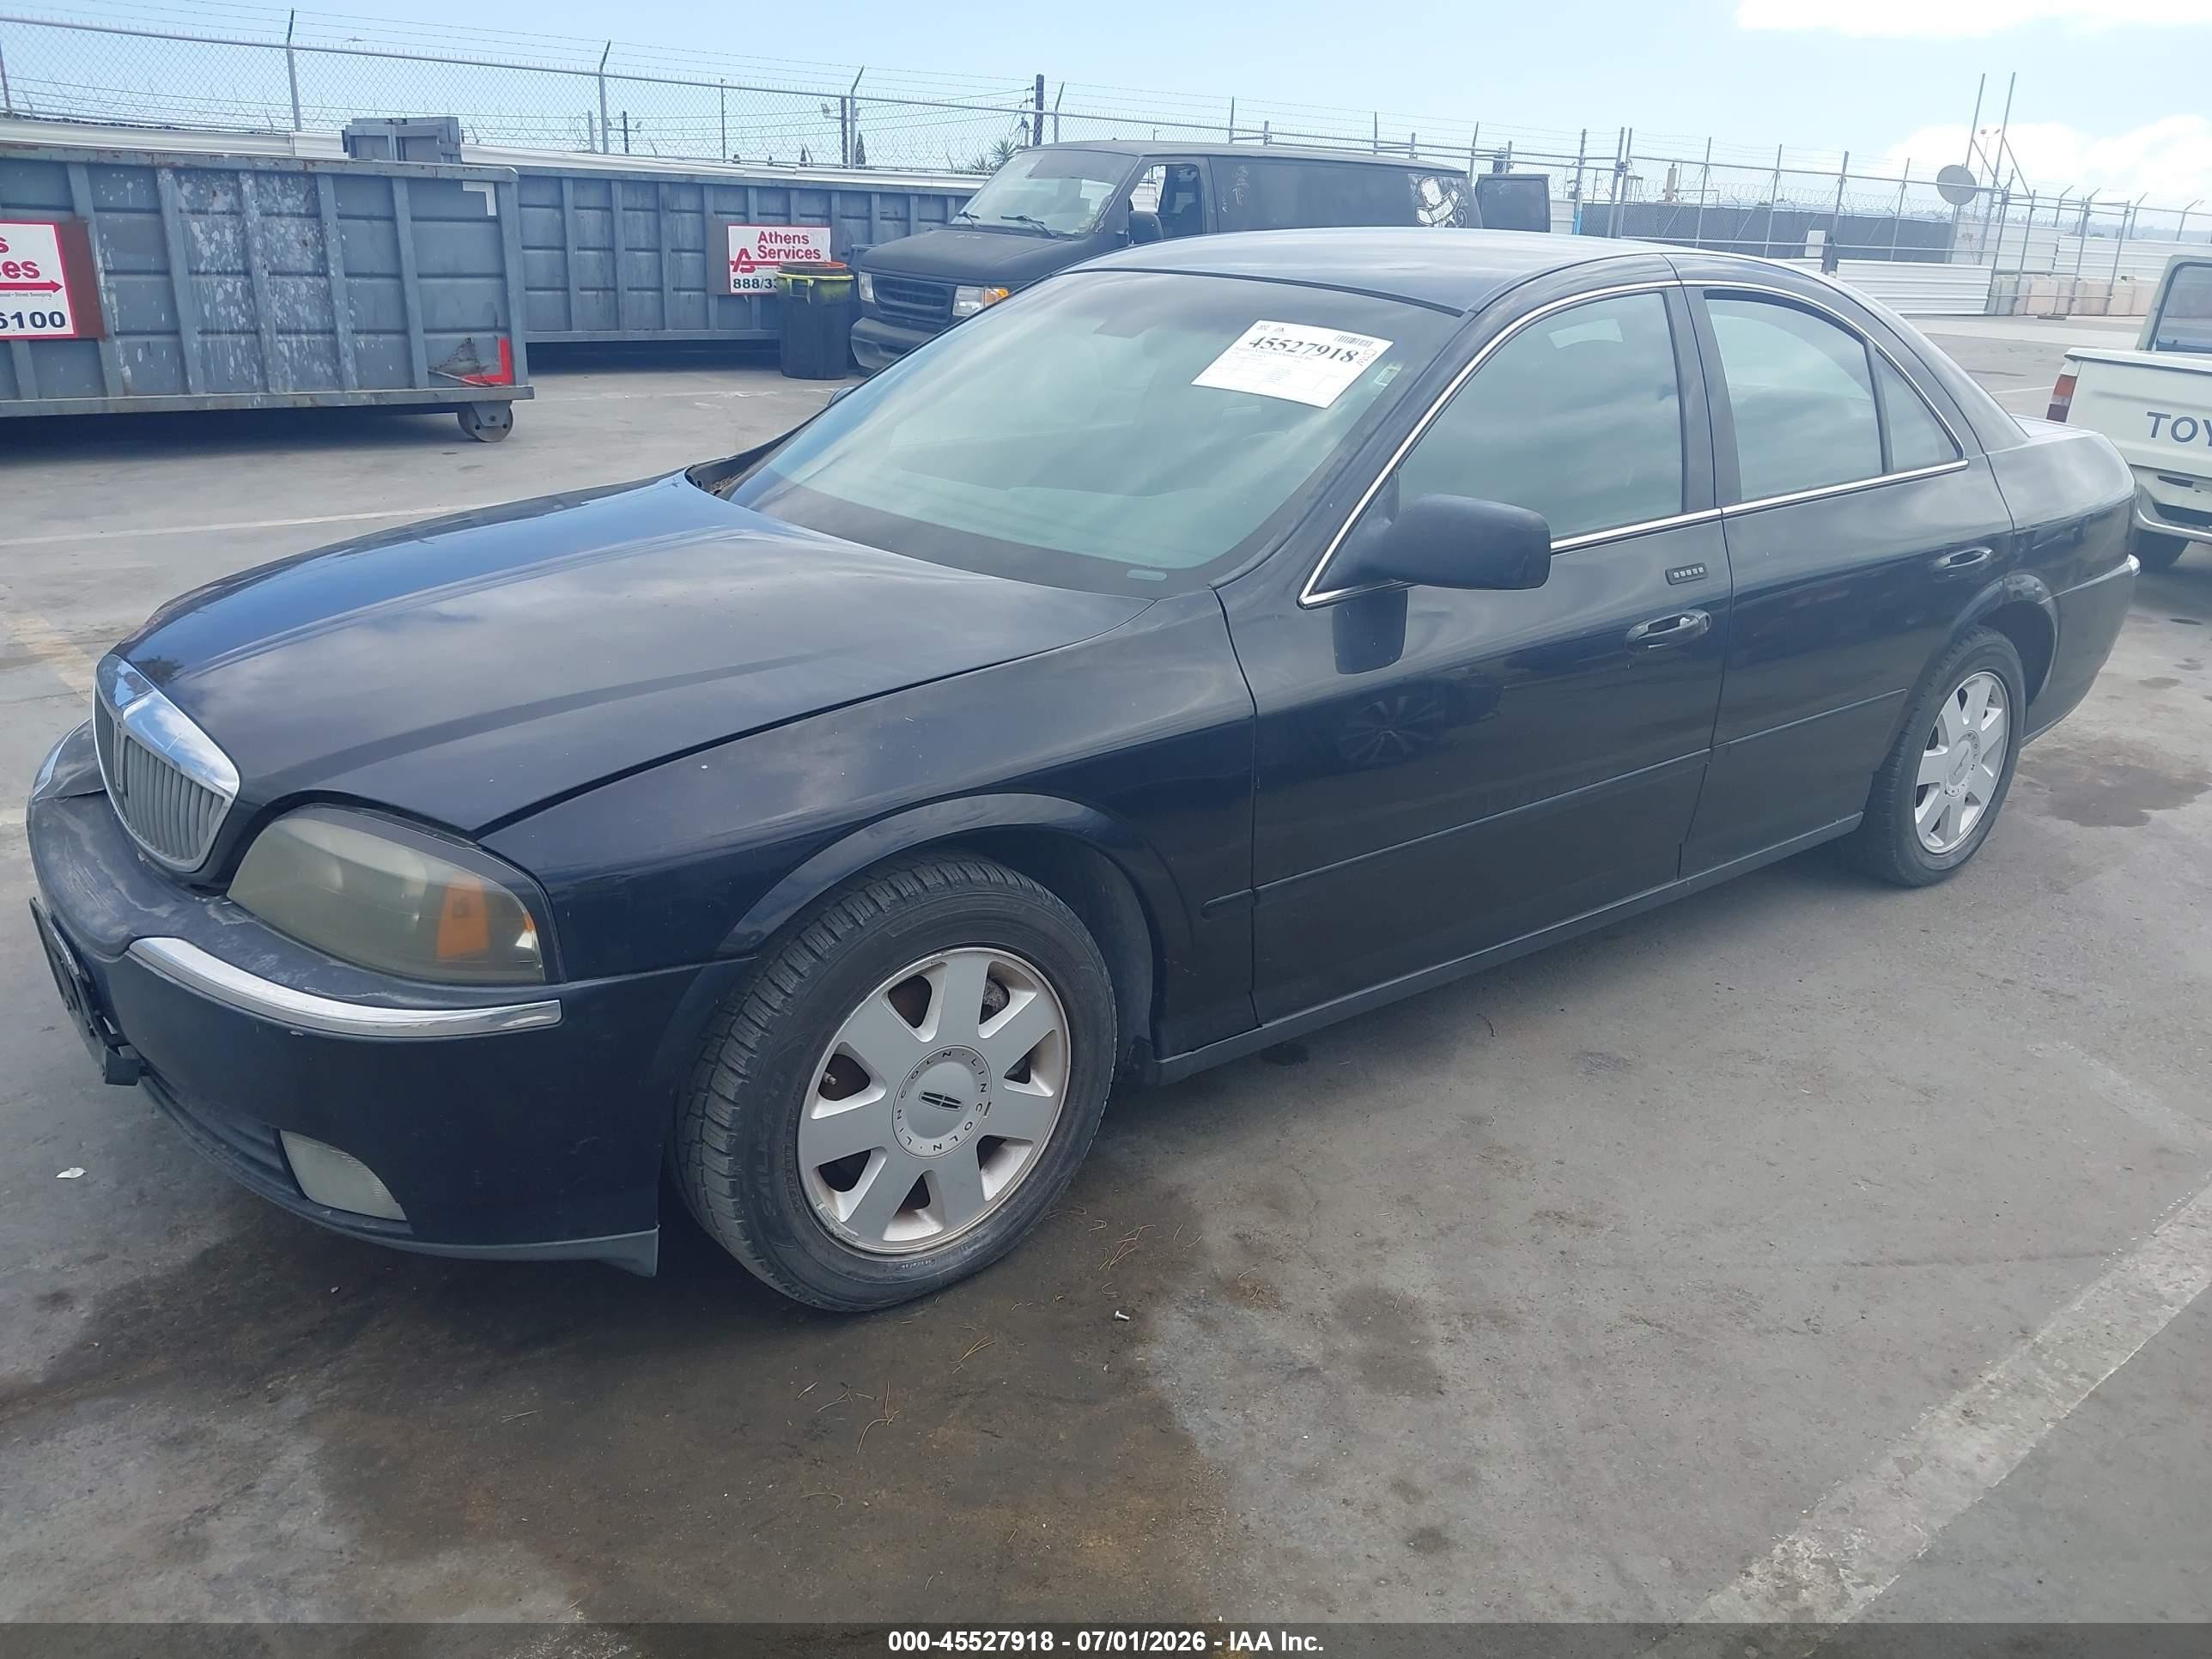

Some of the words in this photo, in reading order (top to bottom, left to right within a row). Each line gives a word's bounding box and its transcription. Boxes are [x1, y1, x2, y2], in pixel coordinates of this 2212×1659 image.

[757, 231, 810, 245] Athens
[757, 245, 821, 259] Services
[0, 260, 40, 279] es
[1249, 336, 1359, 363] 45527918
[896, 1050, 952, 1146] LINCOLN
[933, 1058, 988, 1152] LINCOLN
